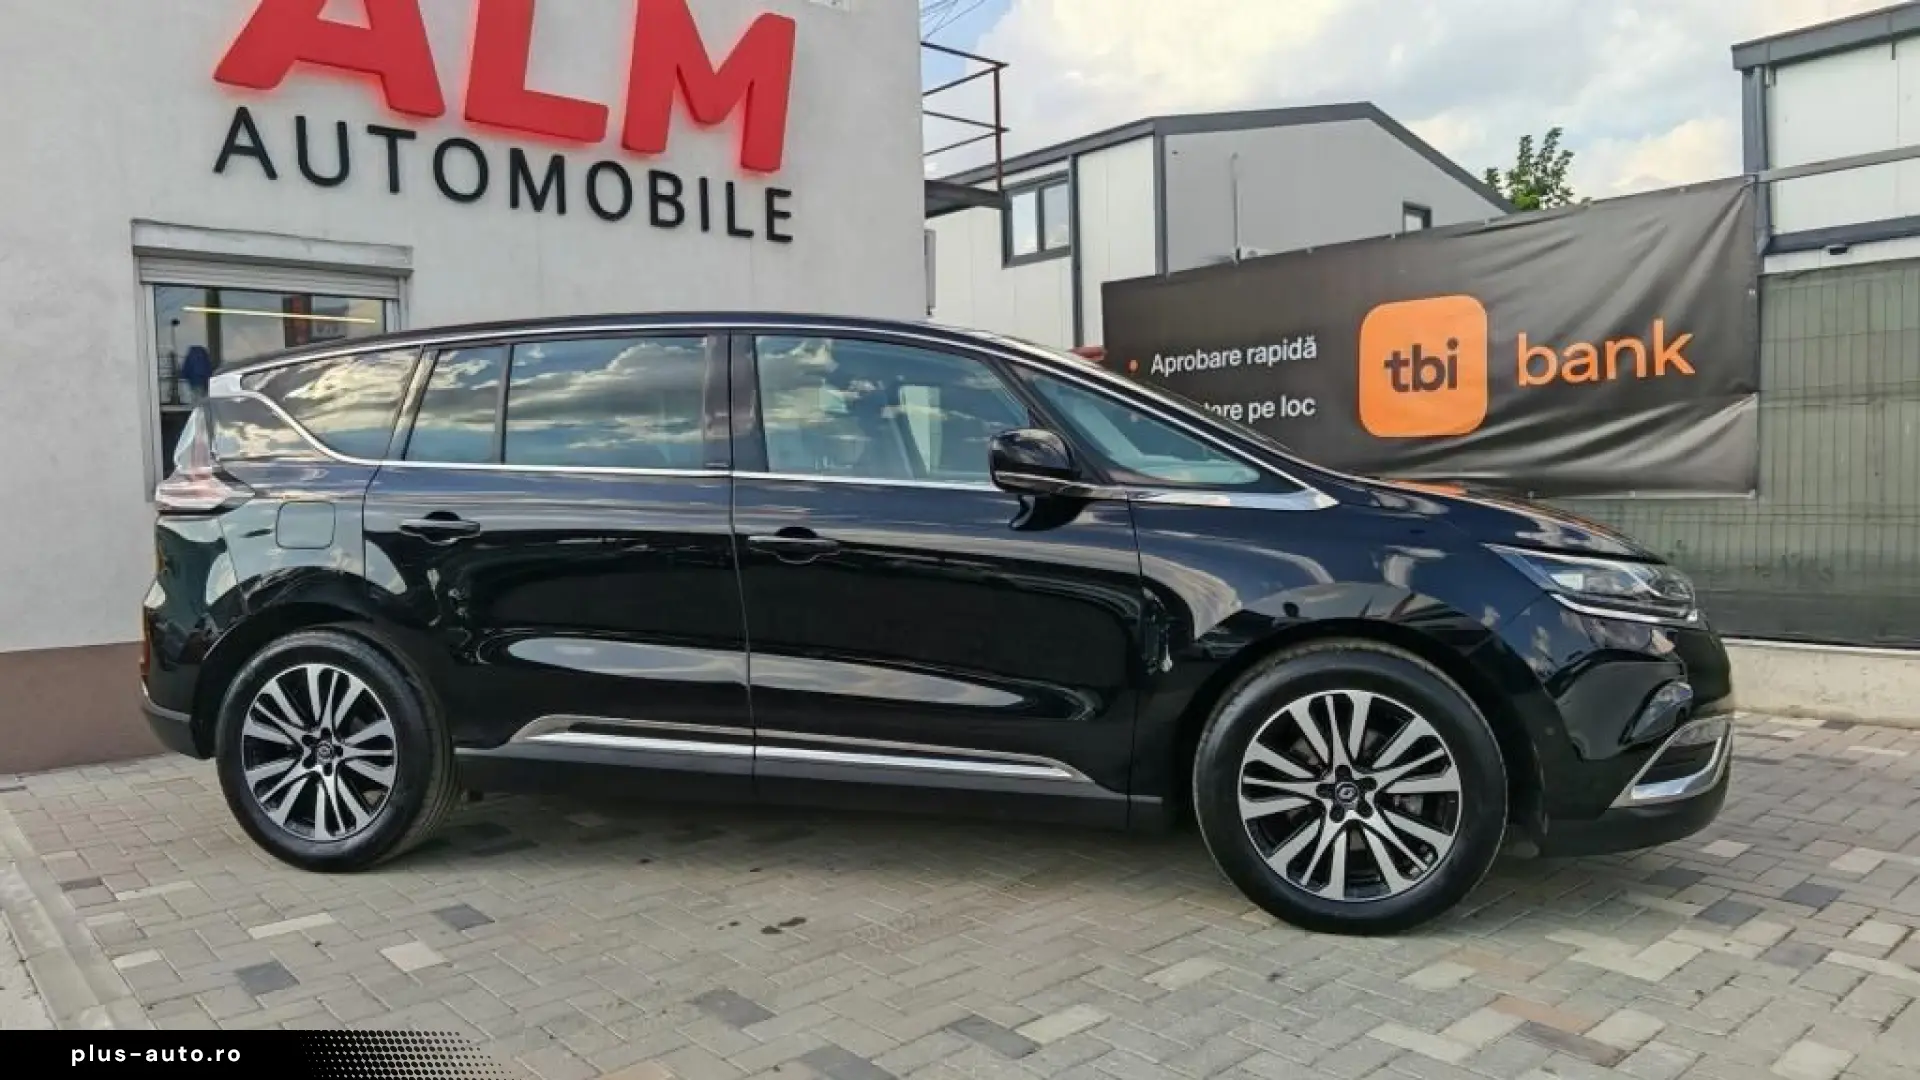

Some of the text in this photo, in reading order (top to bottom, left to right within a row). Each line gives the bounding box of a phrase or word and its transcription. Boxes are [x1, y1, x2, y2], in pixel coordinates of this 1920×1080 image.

[213, 0, 796, 172] ALM
[213, 106, 794, 243] AUTOMOBILE
[1150, 335, 1318, 378] Aprobare rapidă
[1383, 318, 1696, 393] tbi bank
[1248, 400, 1276, 424] pe
[1280, 394, 1317, 418] loc
